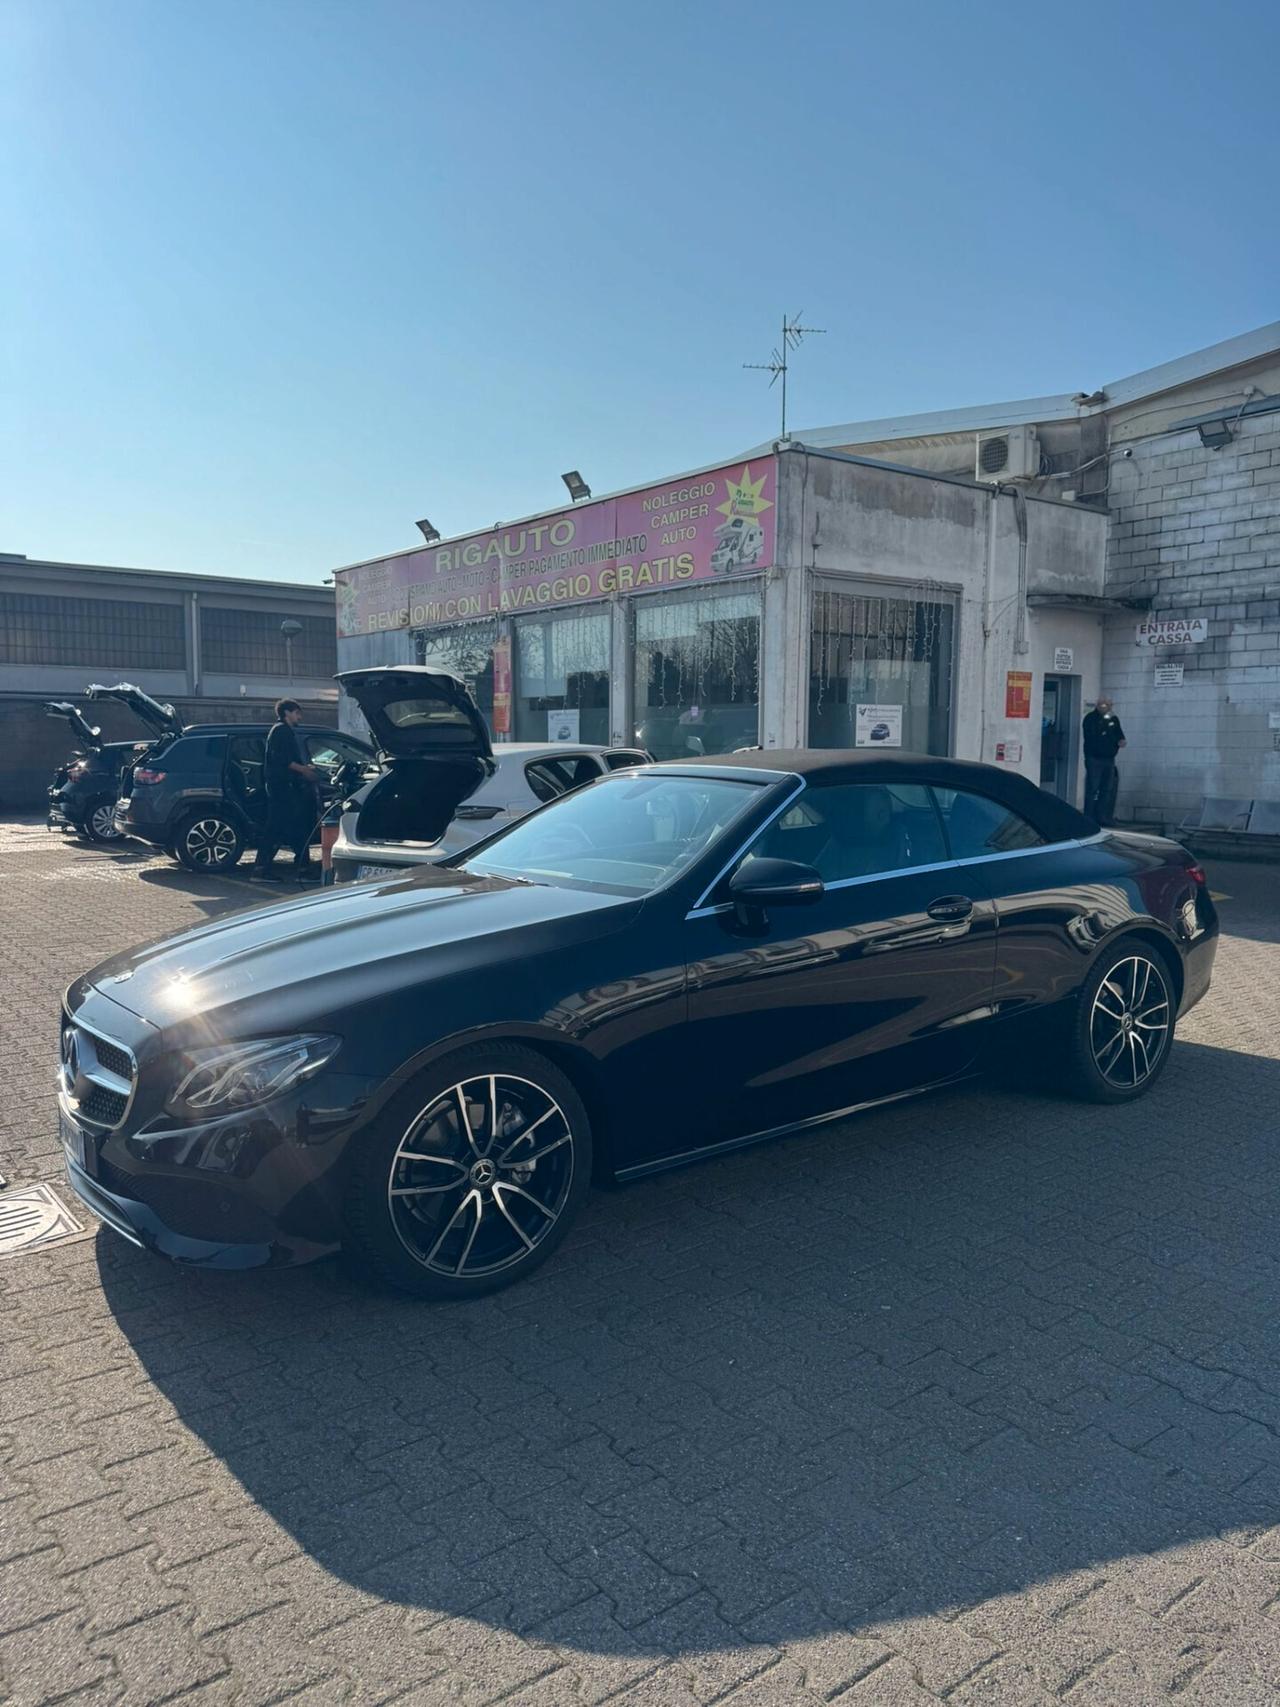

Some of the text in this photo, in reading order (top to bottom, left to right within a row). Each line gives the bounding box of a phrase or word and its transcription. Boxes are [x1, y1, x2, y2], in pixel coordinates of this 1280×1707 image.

[642, 482, 716, 512] NOLEGGIO
[651, 503, 709, 529] CAMPER
[435, 519, 576, 573] RIGAUTO
[660, 526, 697, 546] AUTO
[491, 562, 526, 584] CMPER
[528, 548, 585, 576] PAGAMENTO
[587, 534, 648, 564] IMMEDIATO
[368, 553, 694, 631] REVISIONI CON LAVAGGIO GRATIS
[1140, 620, 1202, 634] ENTRATA
[1148, 632, 1193, 645] CASSA
